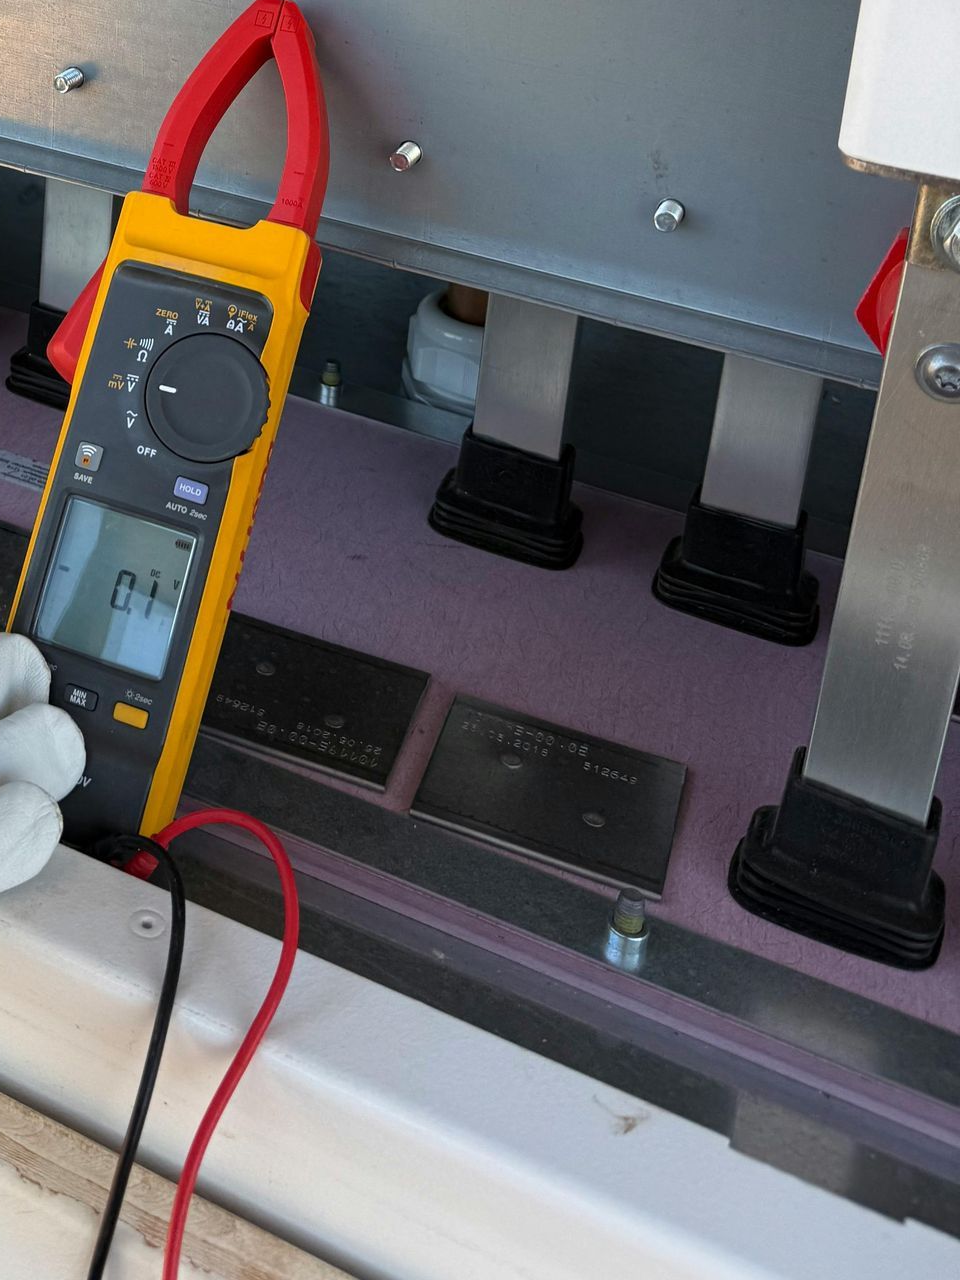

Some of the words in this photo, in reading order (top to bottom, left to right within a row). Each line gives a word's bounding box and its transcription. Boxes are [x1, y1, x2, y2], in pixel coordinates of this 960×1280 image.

[155, 308, 179, 320] ZERO
[136, 445, 158, 458] OFF
[73, 472, 93, 485] SAVE
[179, 482, 202, 497] HOLD
[166, 501, 188, 514] AUTO
[189, 509, 208, 521] 2sec
[150, 568, 161, 579] DC
[173, 579, 180, 591] V
[72, 689, 88, 699] MIN
[70, 695, 87, 708] MAX
